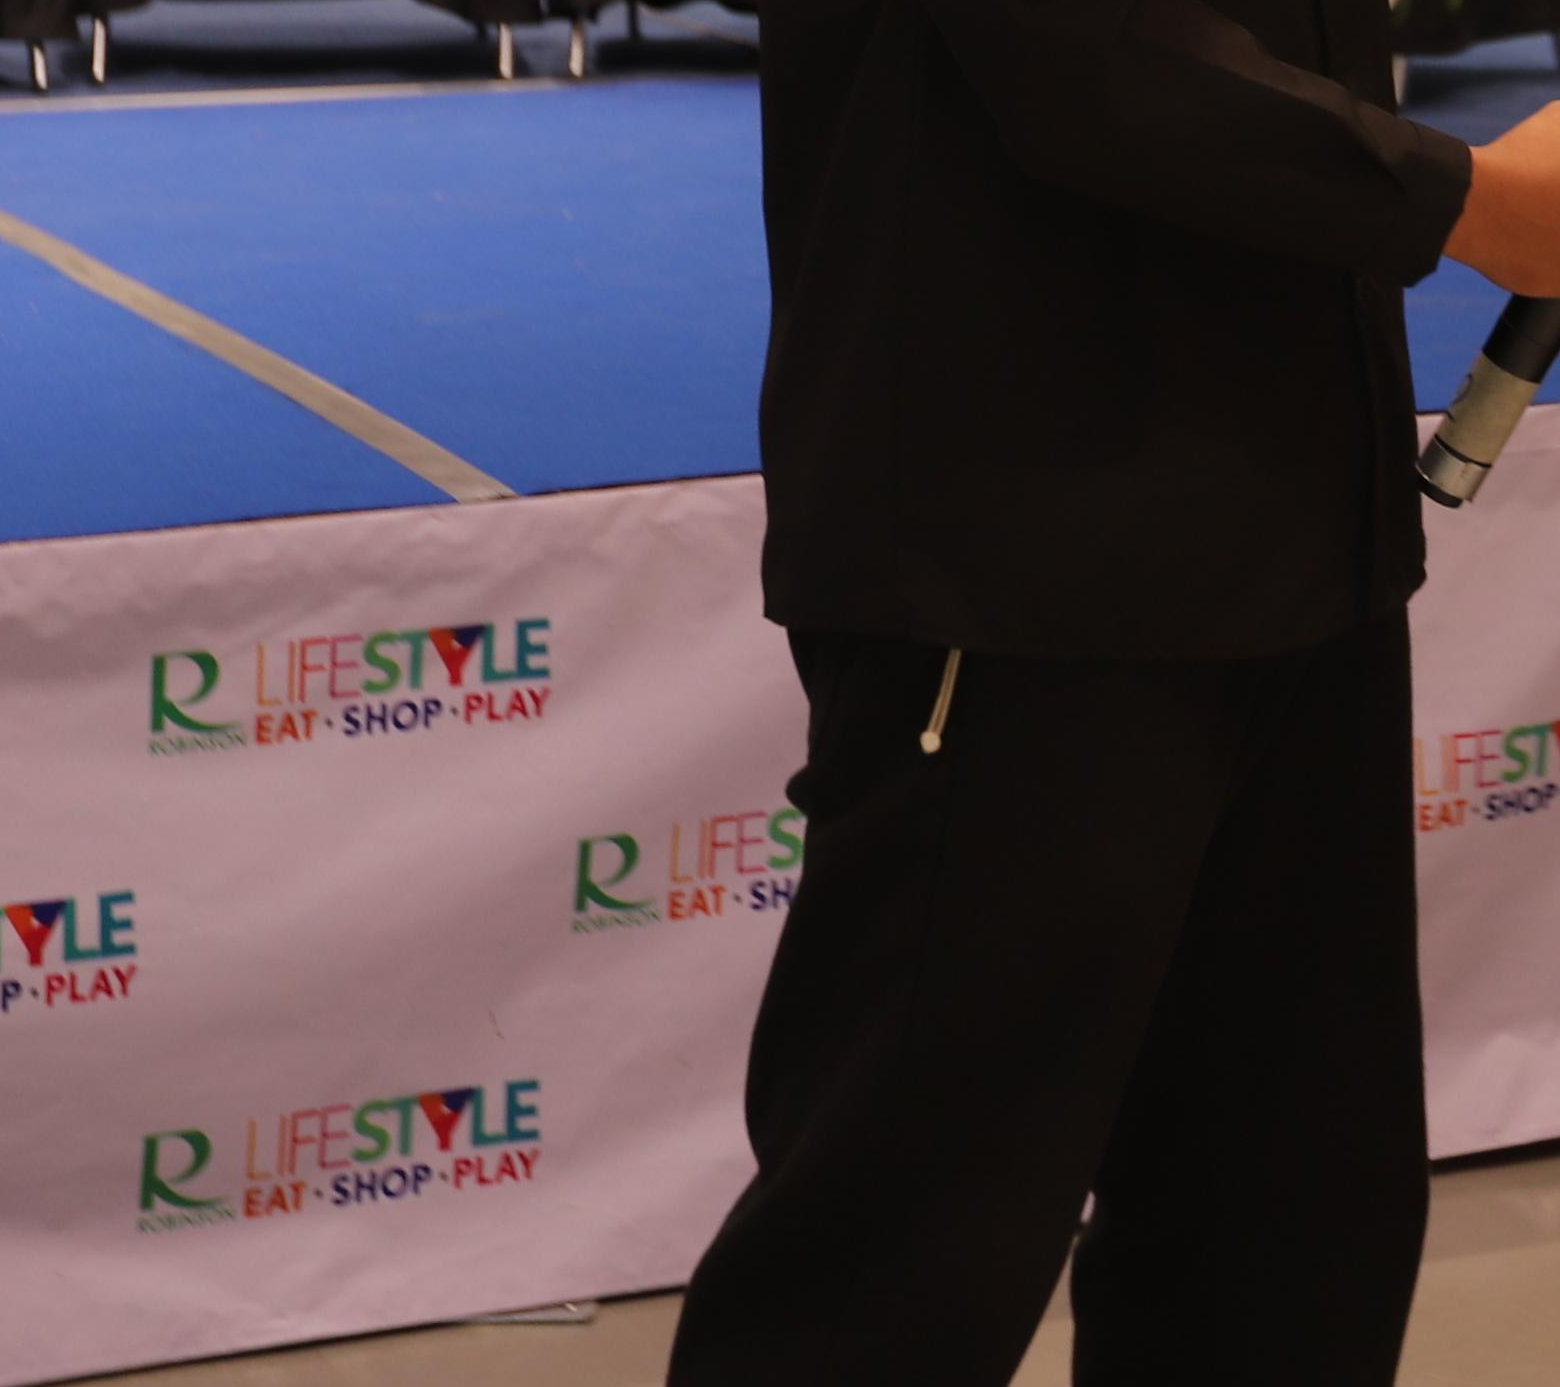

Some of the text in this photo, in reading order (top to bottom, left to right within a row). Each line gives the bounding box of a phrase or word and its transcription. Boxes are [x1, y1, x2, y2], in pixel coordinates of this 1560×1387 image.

[150, 618, 551, 735] R LIFESTYLE
[254, 686, 552, 746] EAT SHOP PLAY
[1418, 798, 1468, 834] EAT
[1485, 781, 1559, 821] SHOP
[574, 832, 660, 913] R
[751, 879, 794, 912] SH
[44, 963, 138, 1008] PLAY
[140, 1078, 541, 1213] R LIFESTYLE
[244, 1147, 541, 1221] EAT SHOP PLAY
